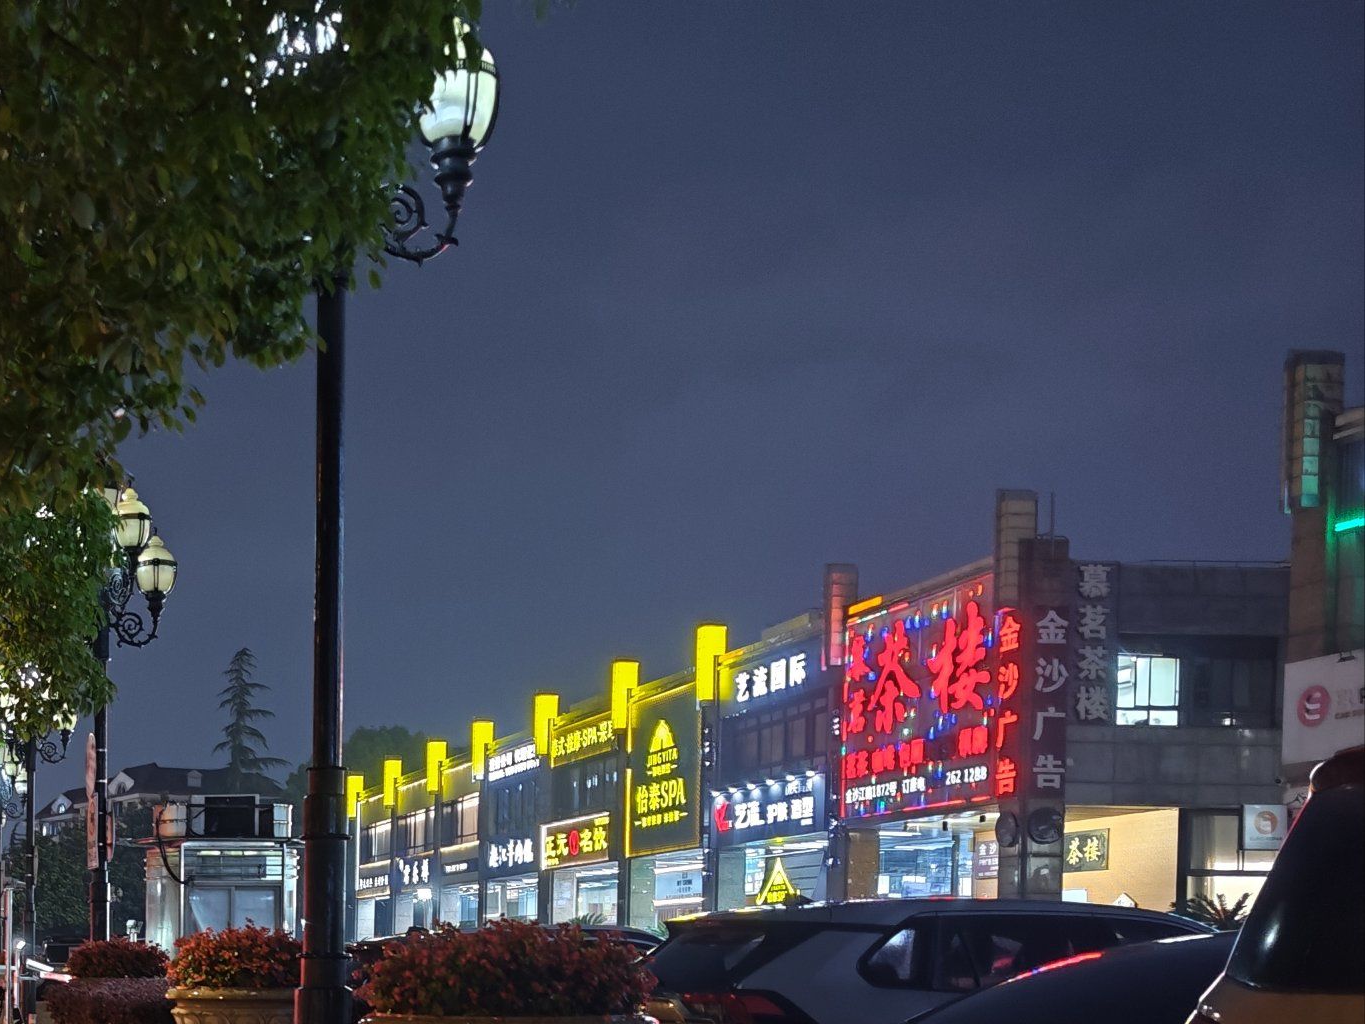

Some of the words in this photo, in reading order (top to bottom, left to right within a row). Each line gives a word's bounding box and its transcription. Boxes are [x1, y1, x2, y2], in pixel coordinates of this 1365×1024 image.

[735, 653, 806, 702] 艺流国际
[868, 601, 991, 734] 茶楼
[995, 615, 1022, 796] 金沙广告
[1033, 610, 1069, 789] 金沙广告
[1076, 564, 1111, 720] 慕茗茶楼
[1067, 837, 1101, 865] 茶楼
